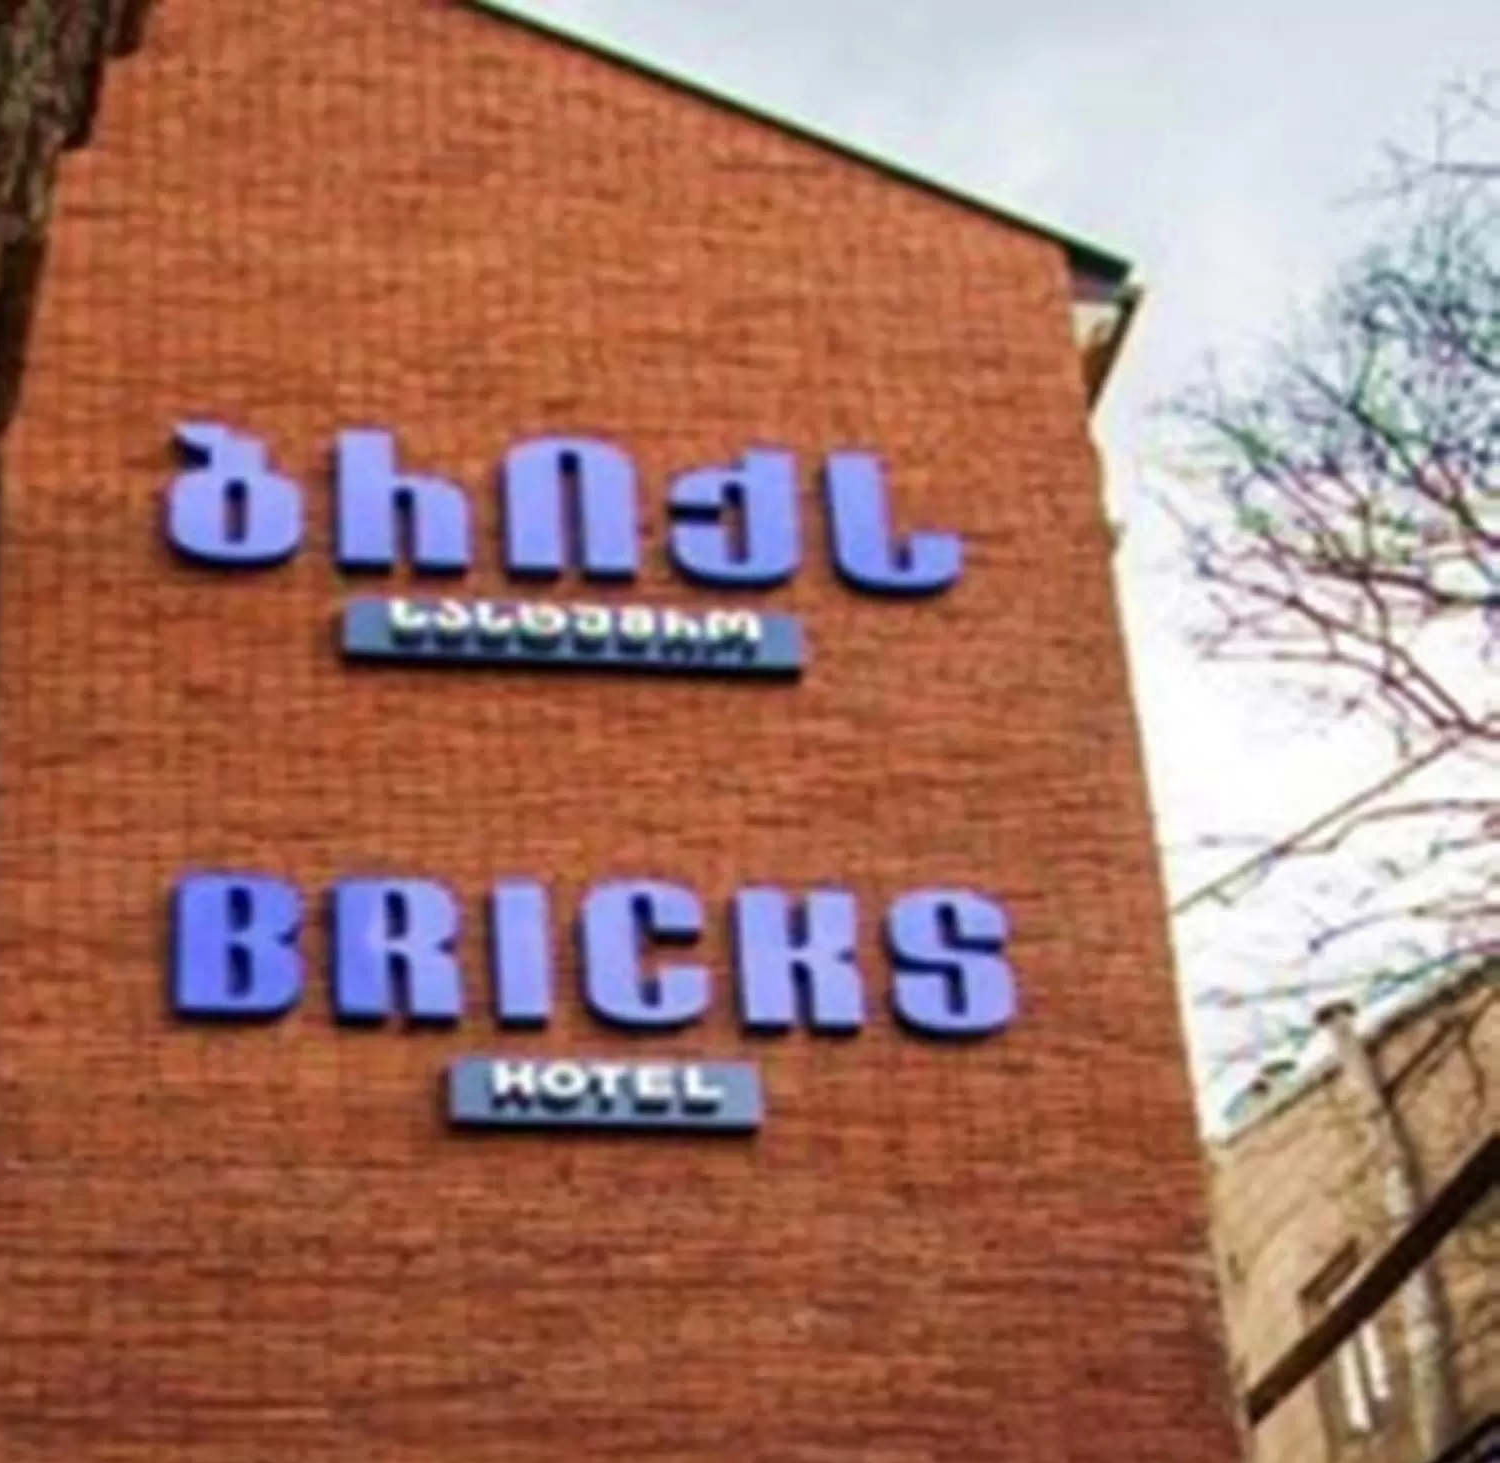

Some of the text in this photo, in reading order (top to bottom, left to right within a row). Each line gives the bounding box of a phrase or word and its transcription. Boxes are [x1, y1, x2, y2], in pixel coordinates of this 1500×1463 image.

[168, 421, 963, 592] ბრიქს
[388, 599, 763, 642] სასტუმრო
[174, 869, 1017, 1035] BRICKS
[492, 1060, 725, 1099] HOTEL
